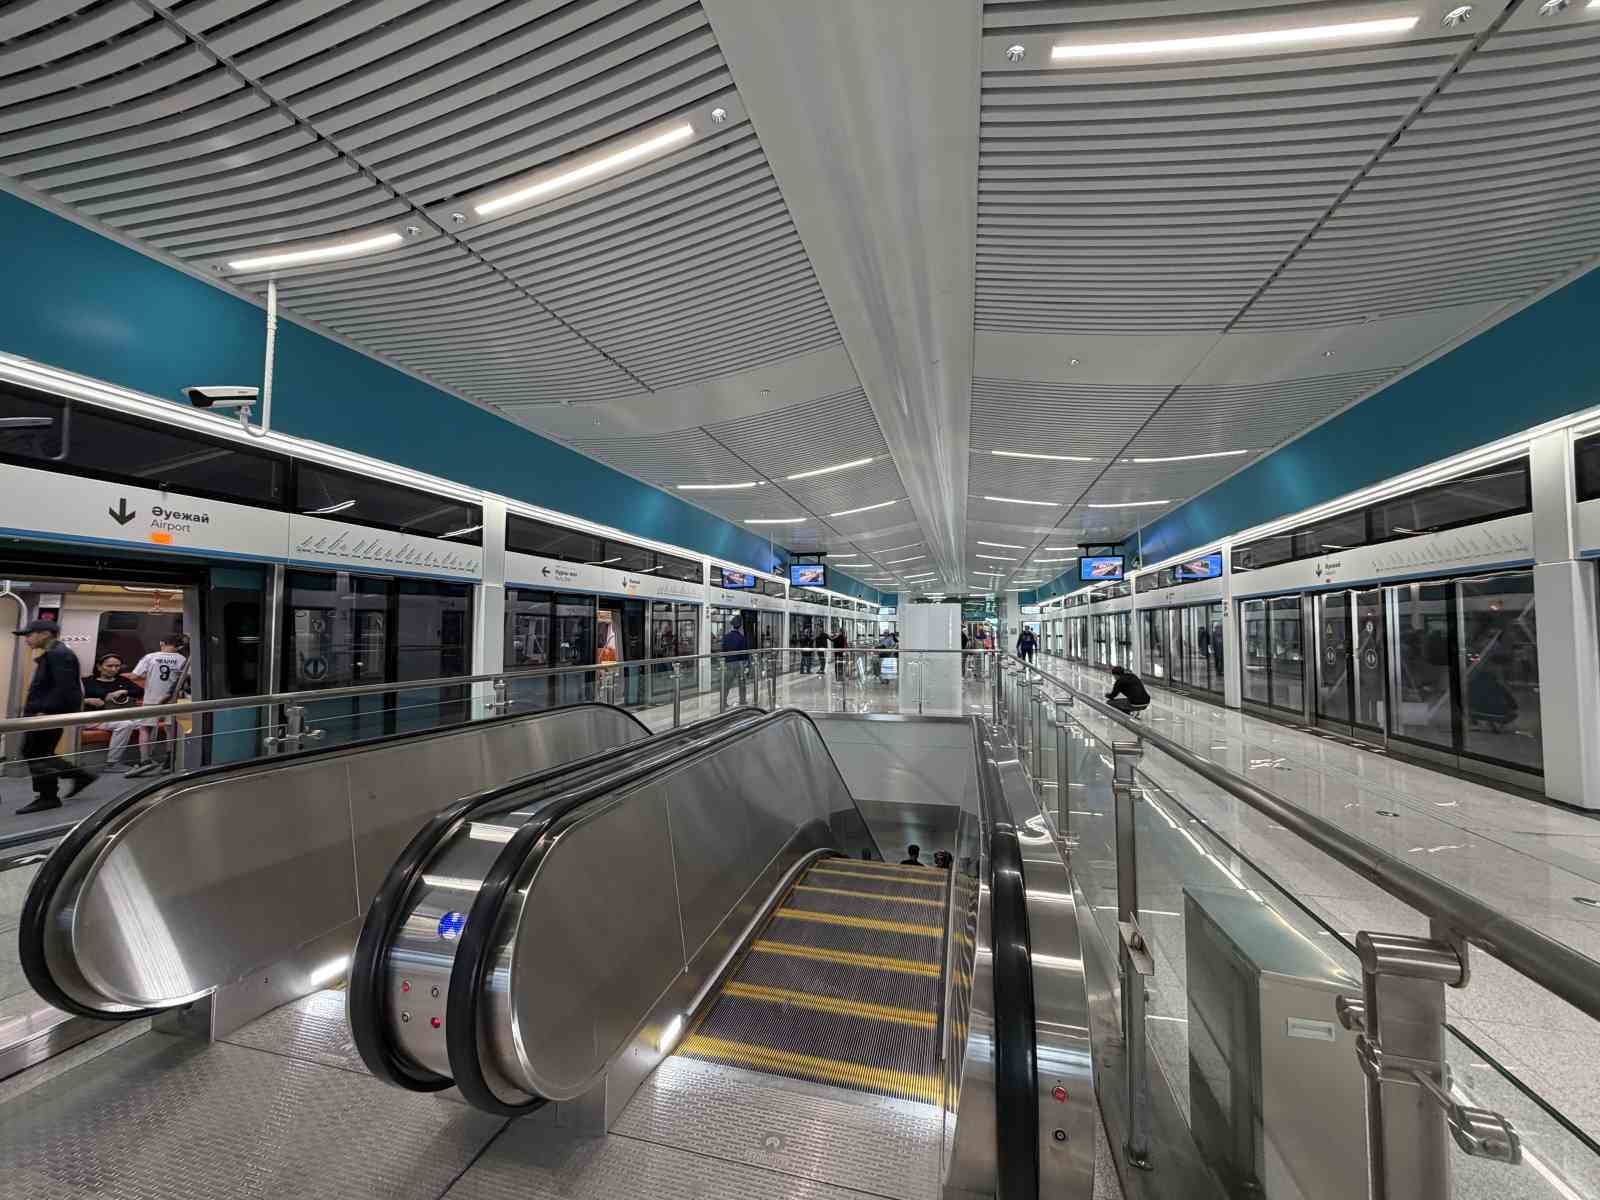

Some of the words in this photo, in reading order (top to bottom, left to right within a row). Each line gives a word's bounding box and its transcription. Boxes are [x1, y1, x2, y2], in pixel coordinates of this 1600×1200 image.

[152, 506, 209, 524] Әуежай
[151, 519, 191, 533] Airport
[159, 664, 170, 681] 9
